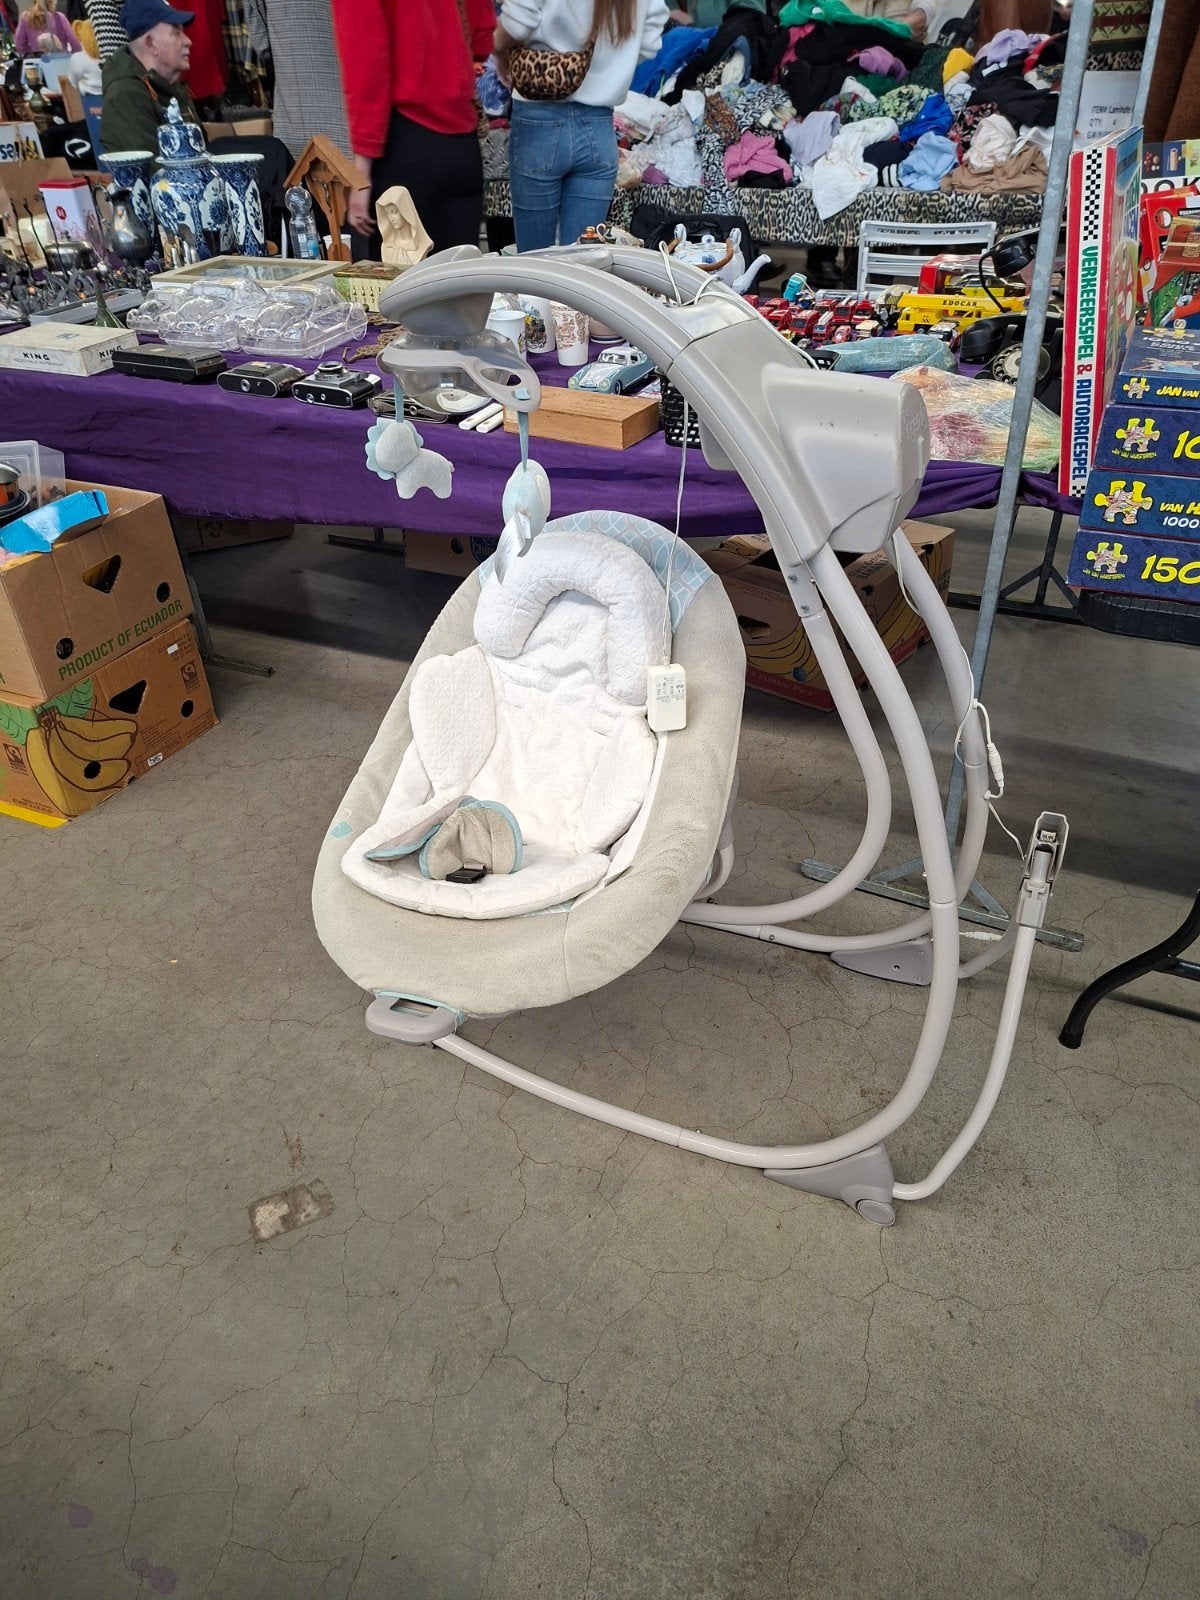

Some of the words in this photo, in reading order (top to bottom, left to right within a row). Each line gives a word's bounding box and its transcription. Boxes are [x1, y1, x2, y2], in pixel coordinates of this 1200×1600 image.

[942, 299, 978, 307] EDOCAR
[1077, 246, 1099, 360] VERKEERSSPEL
[22, 351, 51, 361] KING
[1076, 364, 1093, 376] &
[1156, 385, 1182, 397] JAN
[1182, 390, 1200, 398] VAN
[1072, 379, 1092, 480] AUTORACESPEL
[1159, 502, 1184, 513] VAN
[1162, 516, 1199, 529] 1000
[58, 638, 114, 682] PRODUCT
[117, 628, 132, 647] OF
[134, 598, 184, 638] ECUADOR
